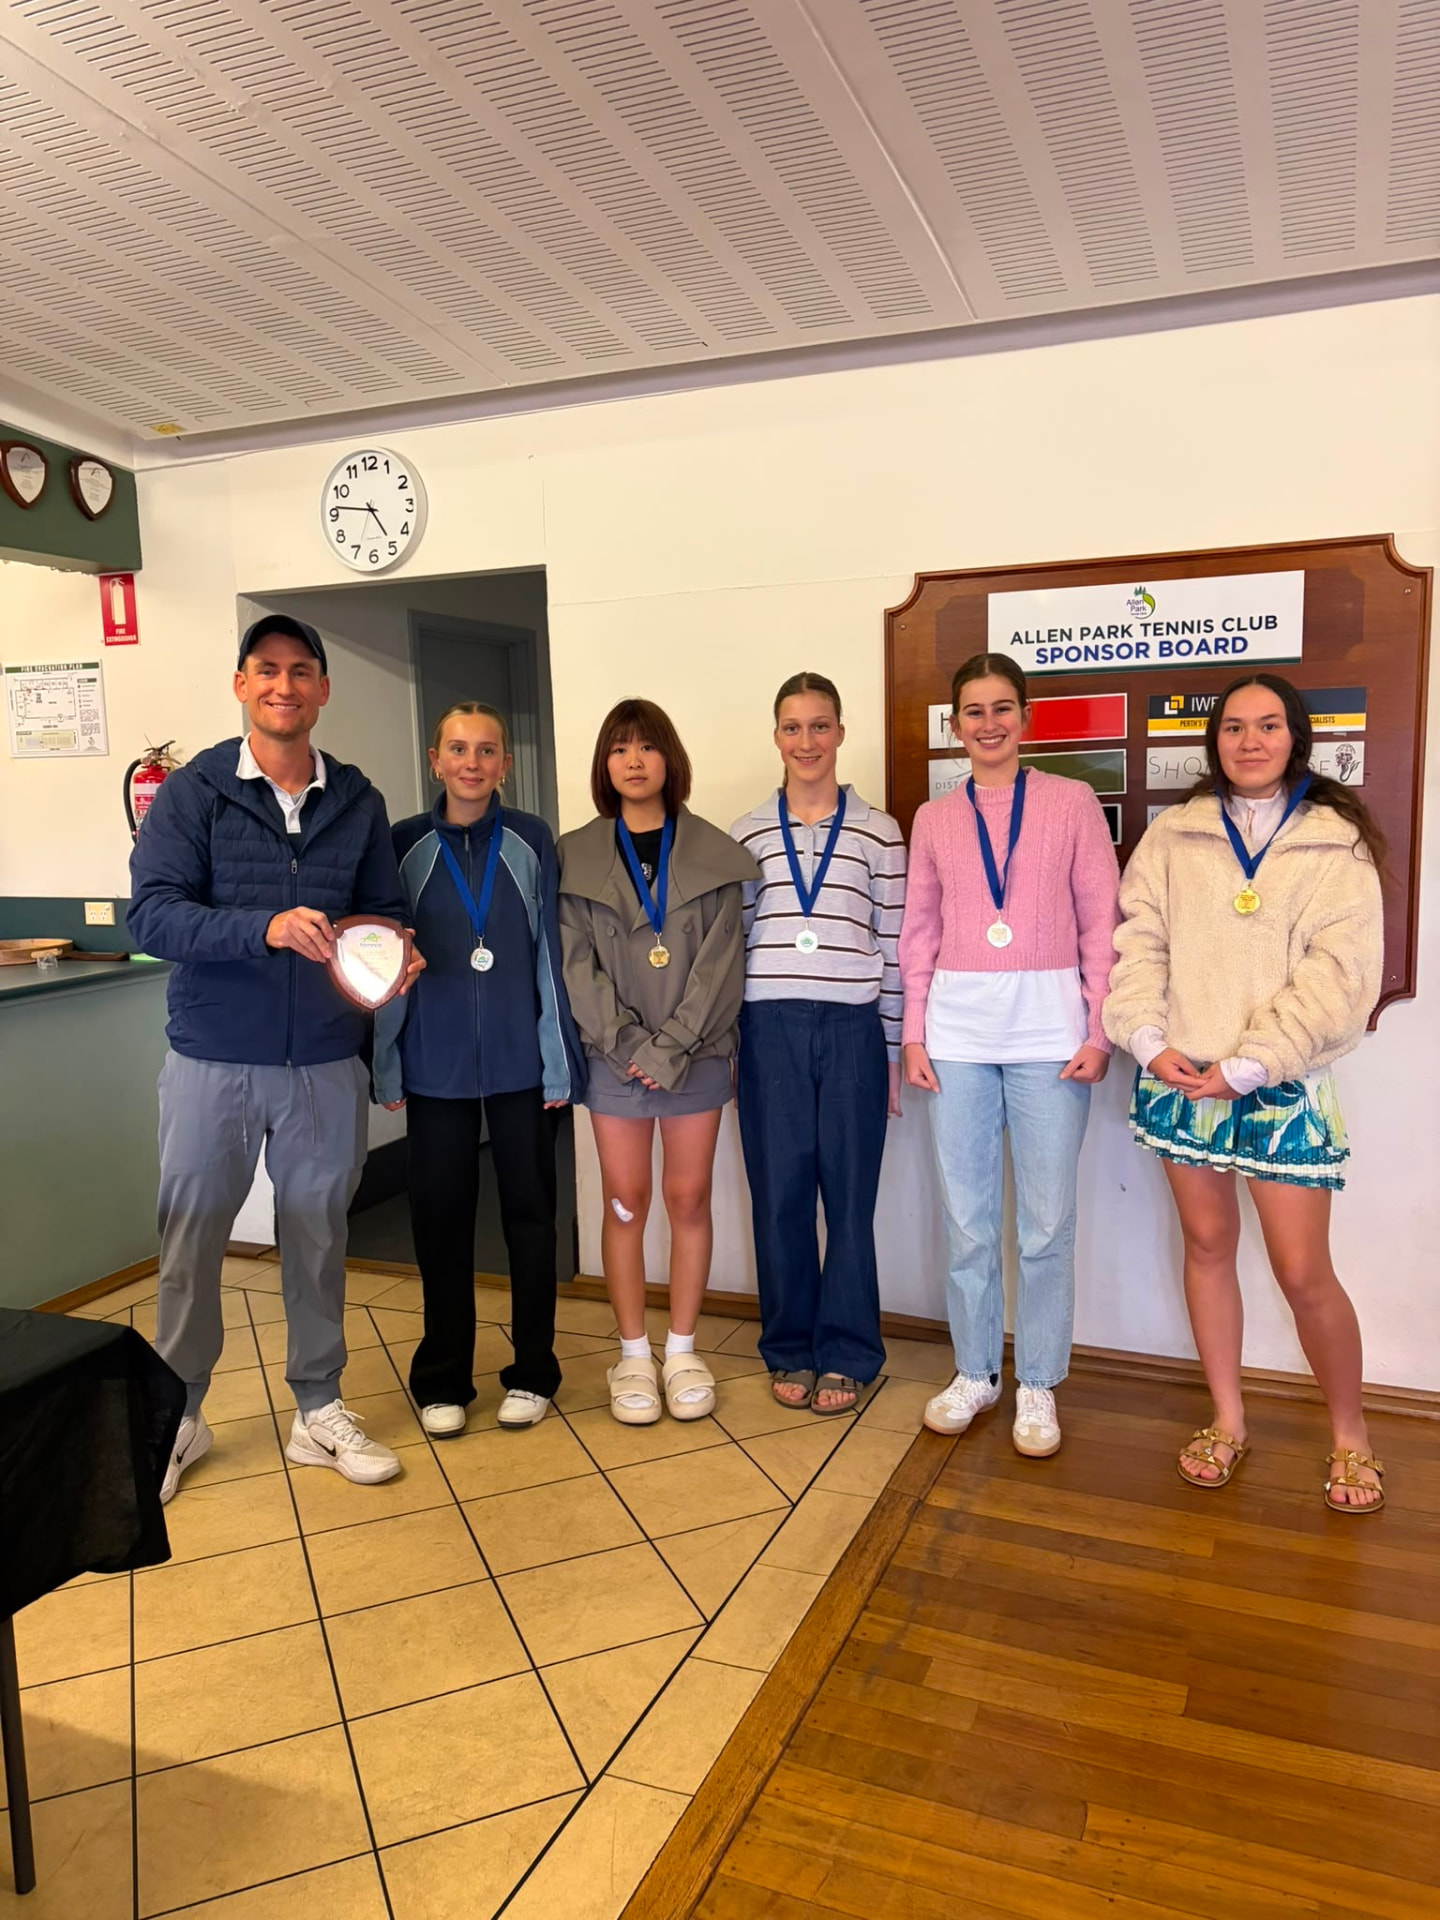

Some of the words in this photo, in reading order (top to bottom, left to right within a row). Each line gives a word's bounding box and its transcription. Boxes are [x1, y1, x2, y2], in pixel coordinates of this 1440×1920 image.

[361, 456, 378, 471] 12
[384, 460, 390, 474] 1
[346, 464, 358, 479] 11
[398, 475, 408, 490] 2
[333, 484, 350, 499] 10
[405, 498, 414, 513] 3
[329, 508, 340, 522] 9
[336, 529, 346, 543] 8
[400, 522, 409, 536] 4
[351, 544, 361, 559] 7
[388, 541, 398, 556] 5
[369, 549, 379, 564] 6
[1010, 627, 1073, 645] ALLEN
[1080, 623, 1133, 641] PARK
[1140, 619, 1215, 637] TENNIS
[1221, 615, 1278, 632] CLUB
[1036, 641, 1150, 665] SPONSOR
[1158, 636, 1249, 657] BOARD
[1310, 716, 1335, 724] CIALISTS
[1149, 756, 1203, 779] SHO
[935, 781, 959, 790] DIST
